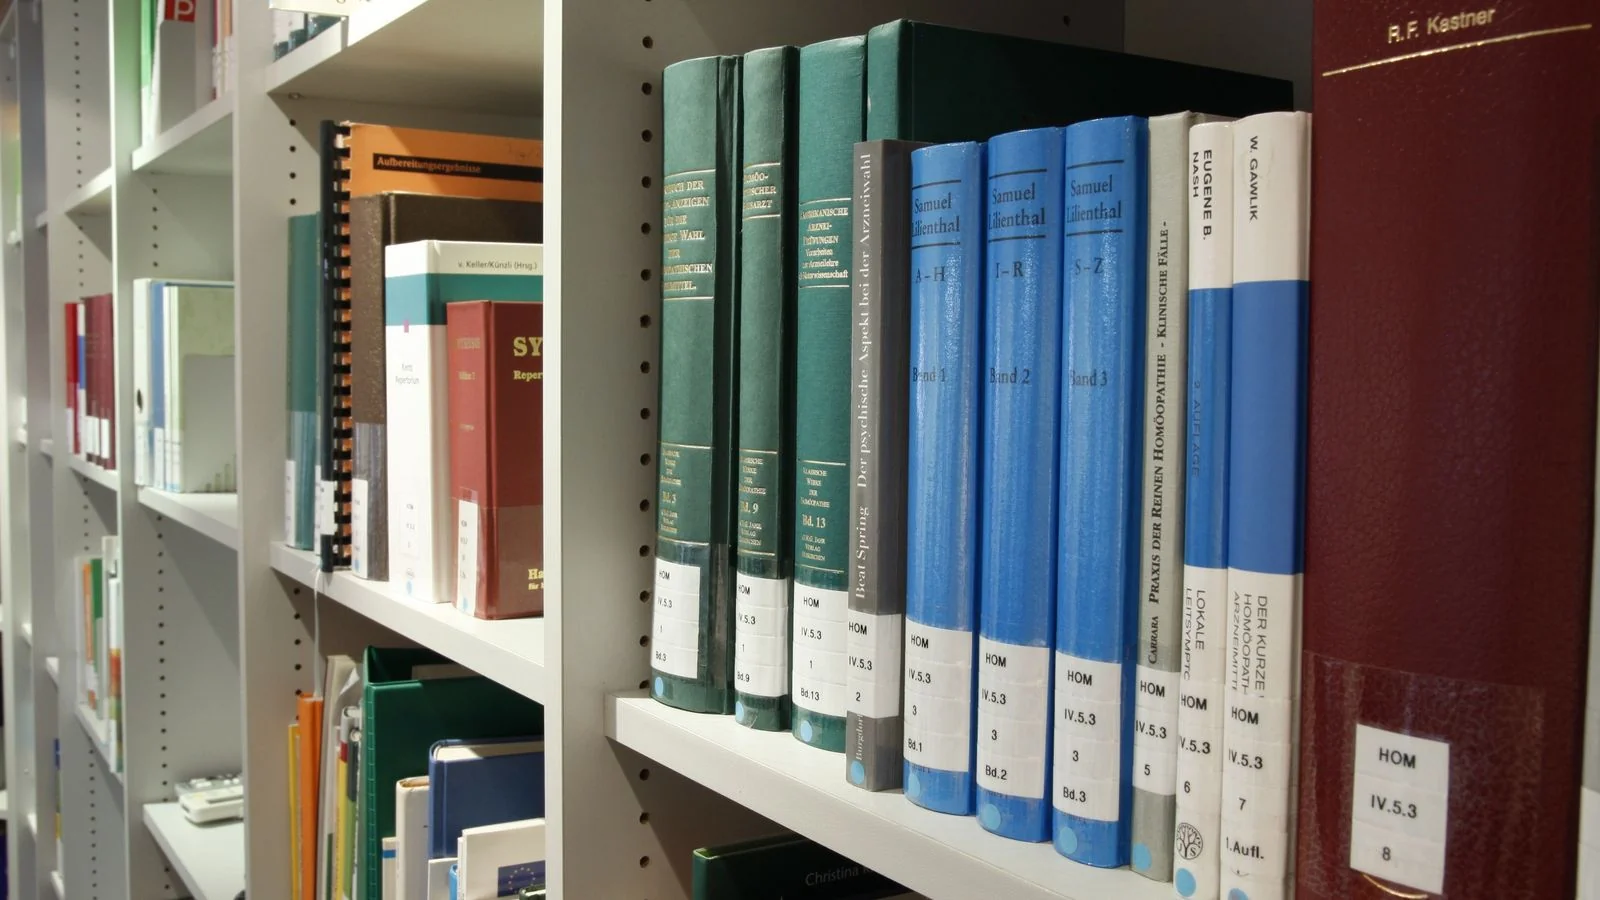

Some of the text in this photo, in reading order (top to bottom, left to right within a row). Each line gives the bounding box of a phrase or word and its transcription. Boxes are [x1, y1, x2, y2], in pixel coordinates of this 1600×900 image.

[1427, 8, 1496, 35] Kastner
[377, 156, 481, 174] Aufbereitungsergebnisse
[687, 180, 704, 190] DER
[1071, 174, 1113, 197] Samuel
[1249, 136, 1258, 221] W. GAWLIK
[992, 182, 1035, 205] Samuel
[1203, 149, 1212, 240] EUGENE B.
[914, 192, 952, 214] Samuel
[988, 207, 1046, 230] Lilienthal
[1066, 200, 1122, 223] Lilienthal
[679, 229, 705, 240] WAHL
[466, 260, 513, 269] Keller/Künzli
[514, 261, 537, 271] (Hrsg.)
[513, 370, 543, 382] Reper
[855, 154, 872, 598] Beat Spring Der psychische Aspekt bei der Arzneiwahl
[1022, 368, 1030, 384] 2
[1100, 370, 1107, 386] 3
[752, 503, 759, 514] 9
[802, 514, 826, 529] Bd. 13
[1152, 522, 1162, 550] DER
[659, 570, 670, 580] HOM
[738, 584, 751, 596] HOM
[803, 597, 820, 608] HOM
[739, 613, 756, 625] V.5.3
[1195, 589, 1206, 650] LOKALE
[801, 627, 822, 640] IV.5.3
[848, 621, 867, 635] HOM
[911, 635, 929, 649] HOM
[1255, 596, 1267, 690] DER KURZE
[656, 651, 667, 661] Bd.3
[848, 656, 873, 671] IV.5.3
[985, 652, 1007, 667] HOM
[737, 671, 750, 682] Bd.9
[909, 668, 931, 684] IV.5.3
[1067, 670, 1093, 686] HOM
[800, 687, 820, 701] Bd.13
[855, 692, 861, 702] 2
[981, 688, 1006, 705] IV.5.3
[1140, 680, 1165, 698] HOM
[912, 705, 917, 716] 3
[1181, 694, 1207, 711] HOM
[1064, 708, 1096, 726] IV.5.3
[1231, 706, 1259, 725] HOM
[991, 729, 998, 741] 3
[1135, 719, 1167, 739] IV.5.3
[908, 738, 923, 752] Bd.1
[1180, 735, 1211, 754] V.5.3
[1072, 750, 1079, 762] 3
[1229, 748, 1263, 770] IV.5.3
[1379, 747, 1416, 769] HOM
[985, 765, 1007, 780] Bd.2
[1144, 764, 1151, 776] 5
[1063, 787, 1086, 803] Bd.3
[1184, 780, 1191, 794] 6
[1239, 797, 1246, 811] 7
[1371, 794, 1417, 819] IV.5.3
[1226, 836, 1264, 859] 1.Aufl.
[1382, 846, 1391, 861] 8
[805, 866, 859, 886] Christina
